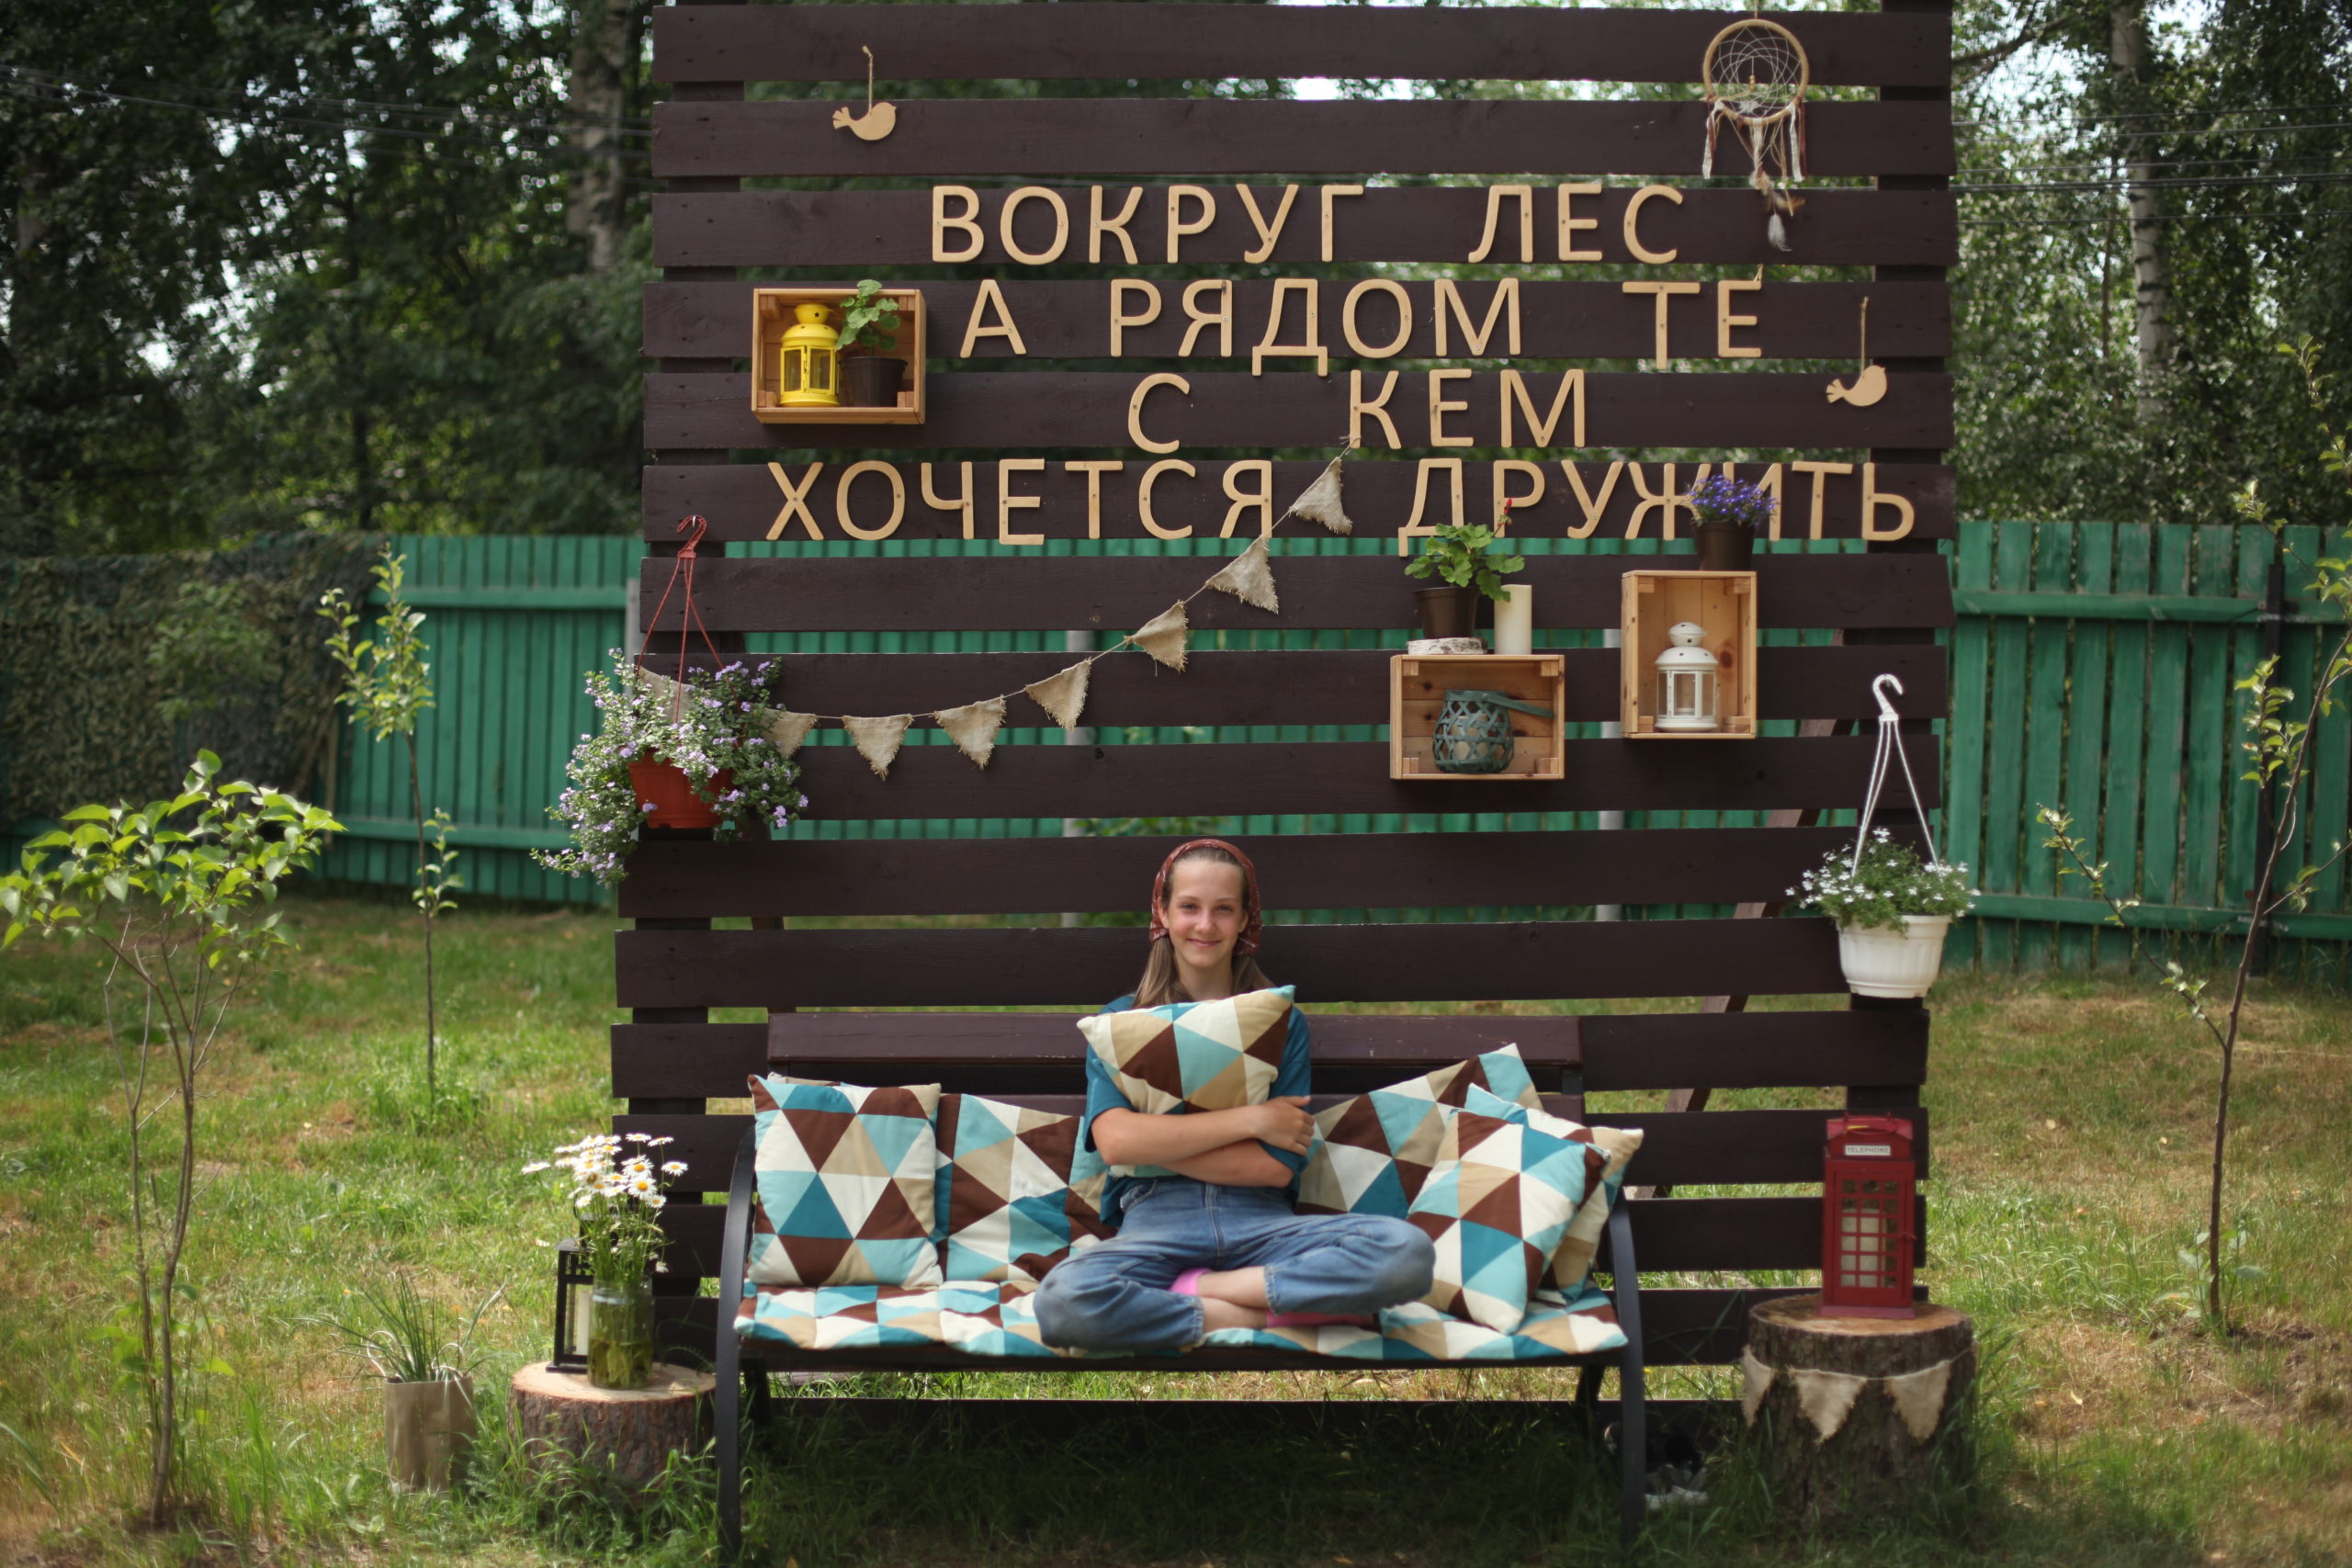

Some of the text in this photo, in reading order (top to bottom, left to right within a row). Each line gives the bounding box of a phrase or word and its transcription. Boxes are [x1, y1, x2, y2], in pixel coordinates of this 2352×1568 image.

[932, 183, 1683, 265] ВОКРУГ ЛЕС
[959, 277, 1762, 377] А РЯДОМ ТЕ
[1127, 369, 1587, 453] С КЕМ
[765, 458, 1273, 545] ХОЧЕТСЯ
